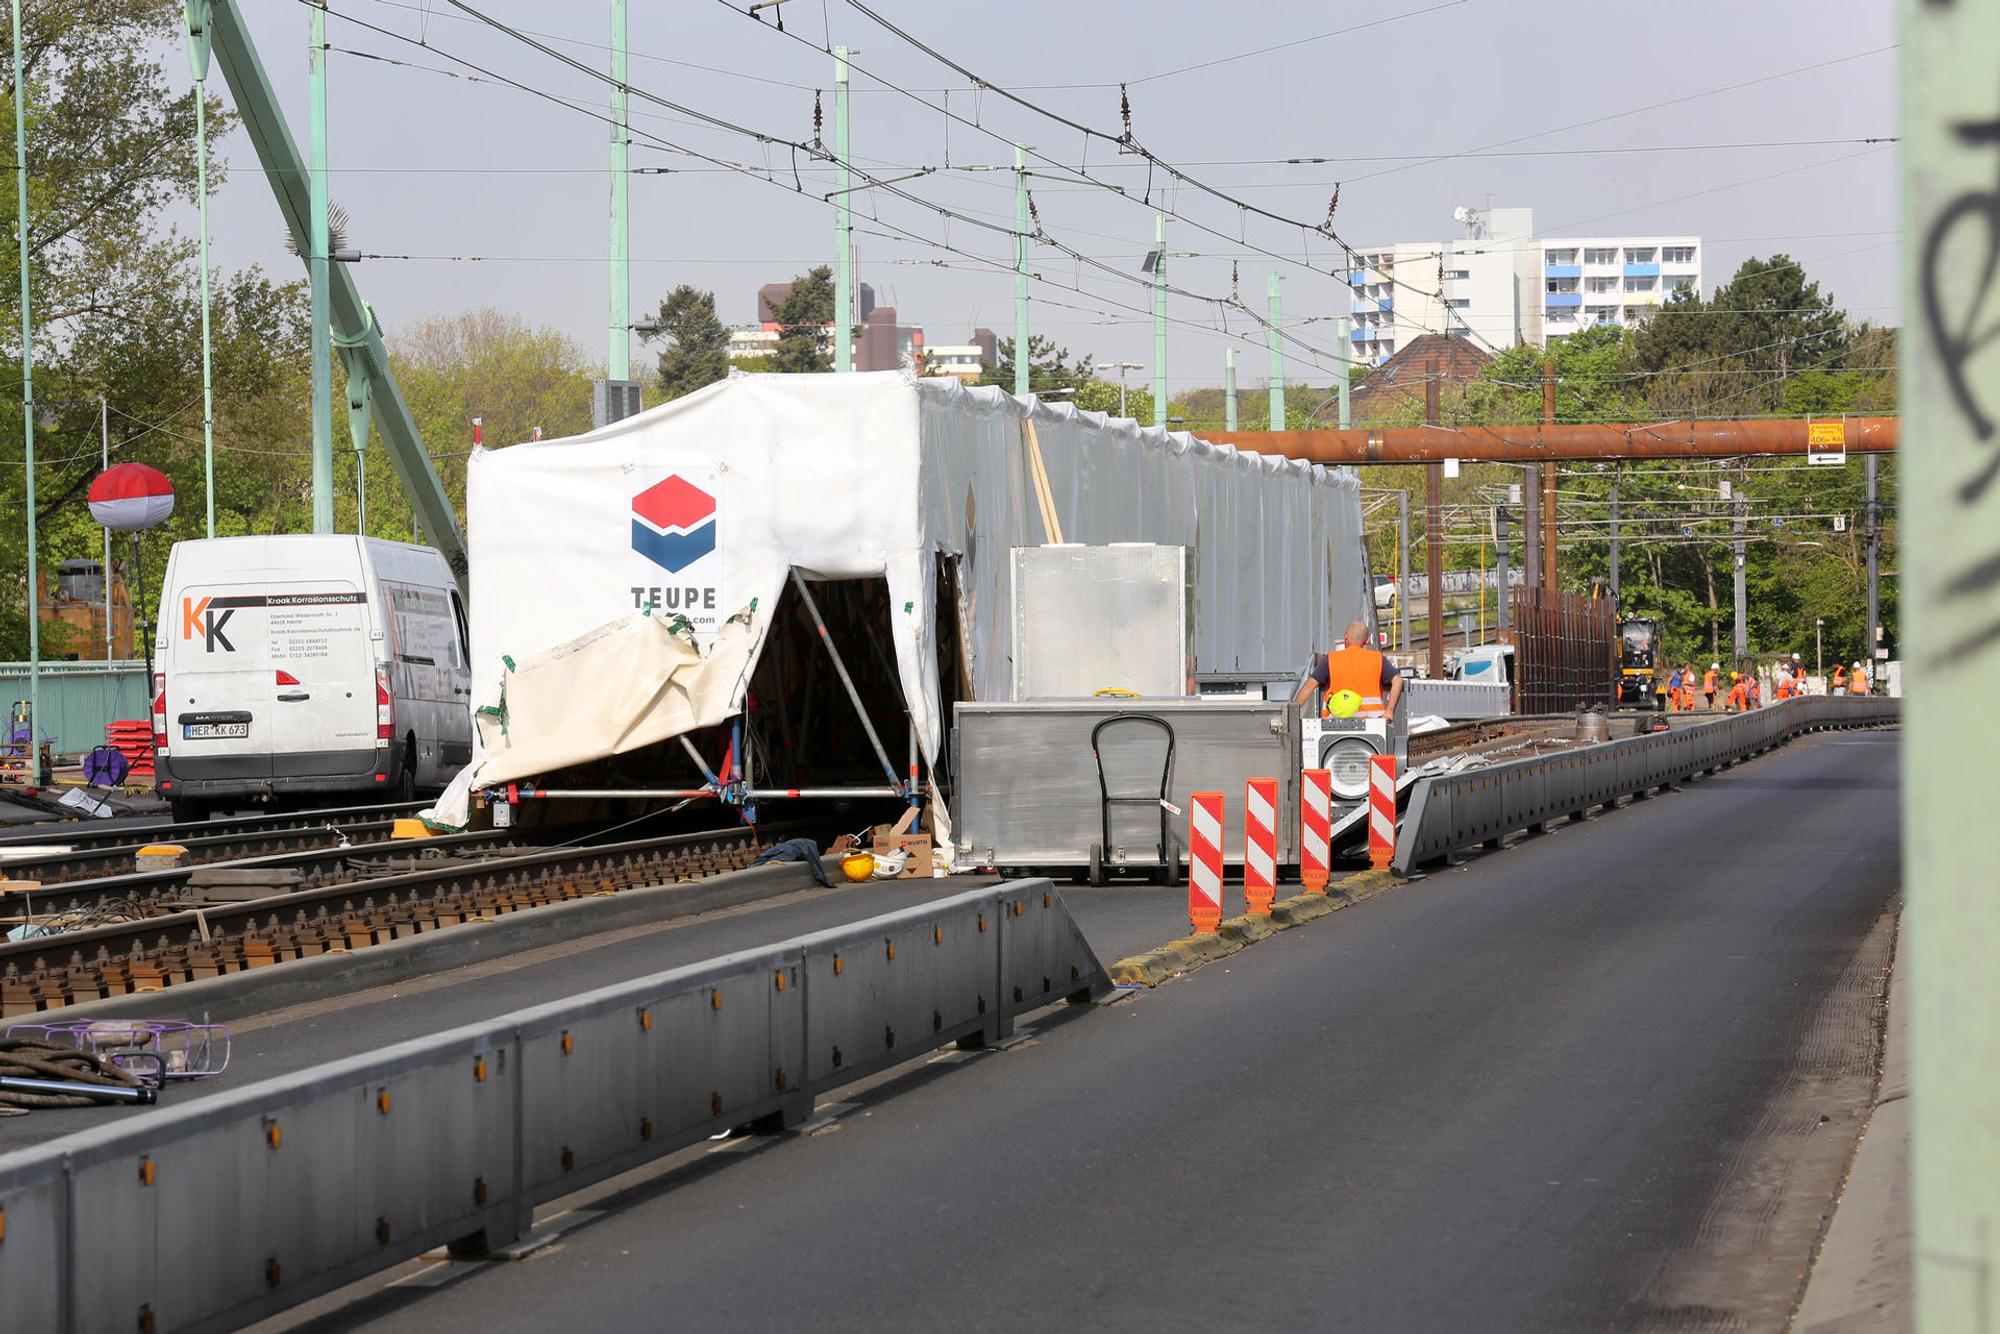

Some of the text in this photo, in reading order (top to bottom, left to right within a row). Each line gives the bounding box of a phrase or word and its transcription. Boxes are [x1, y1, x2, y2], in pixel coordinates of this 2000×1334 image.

[292, 595, 358, 604] Korrosionsschutz
[631, 587, 716, 609] TEUPE
[191, 724, 246, 736] HER KK 673
